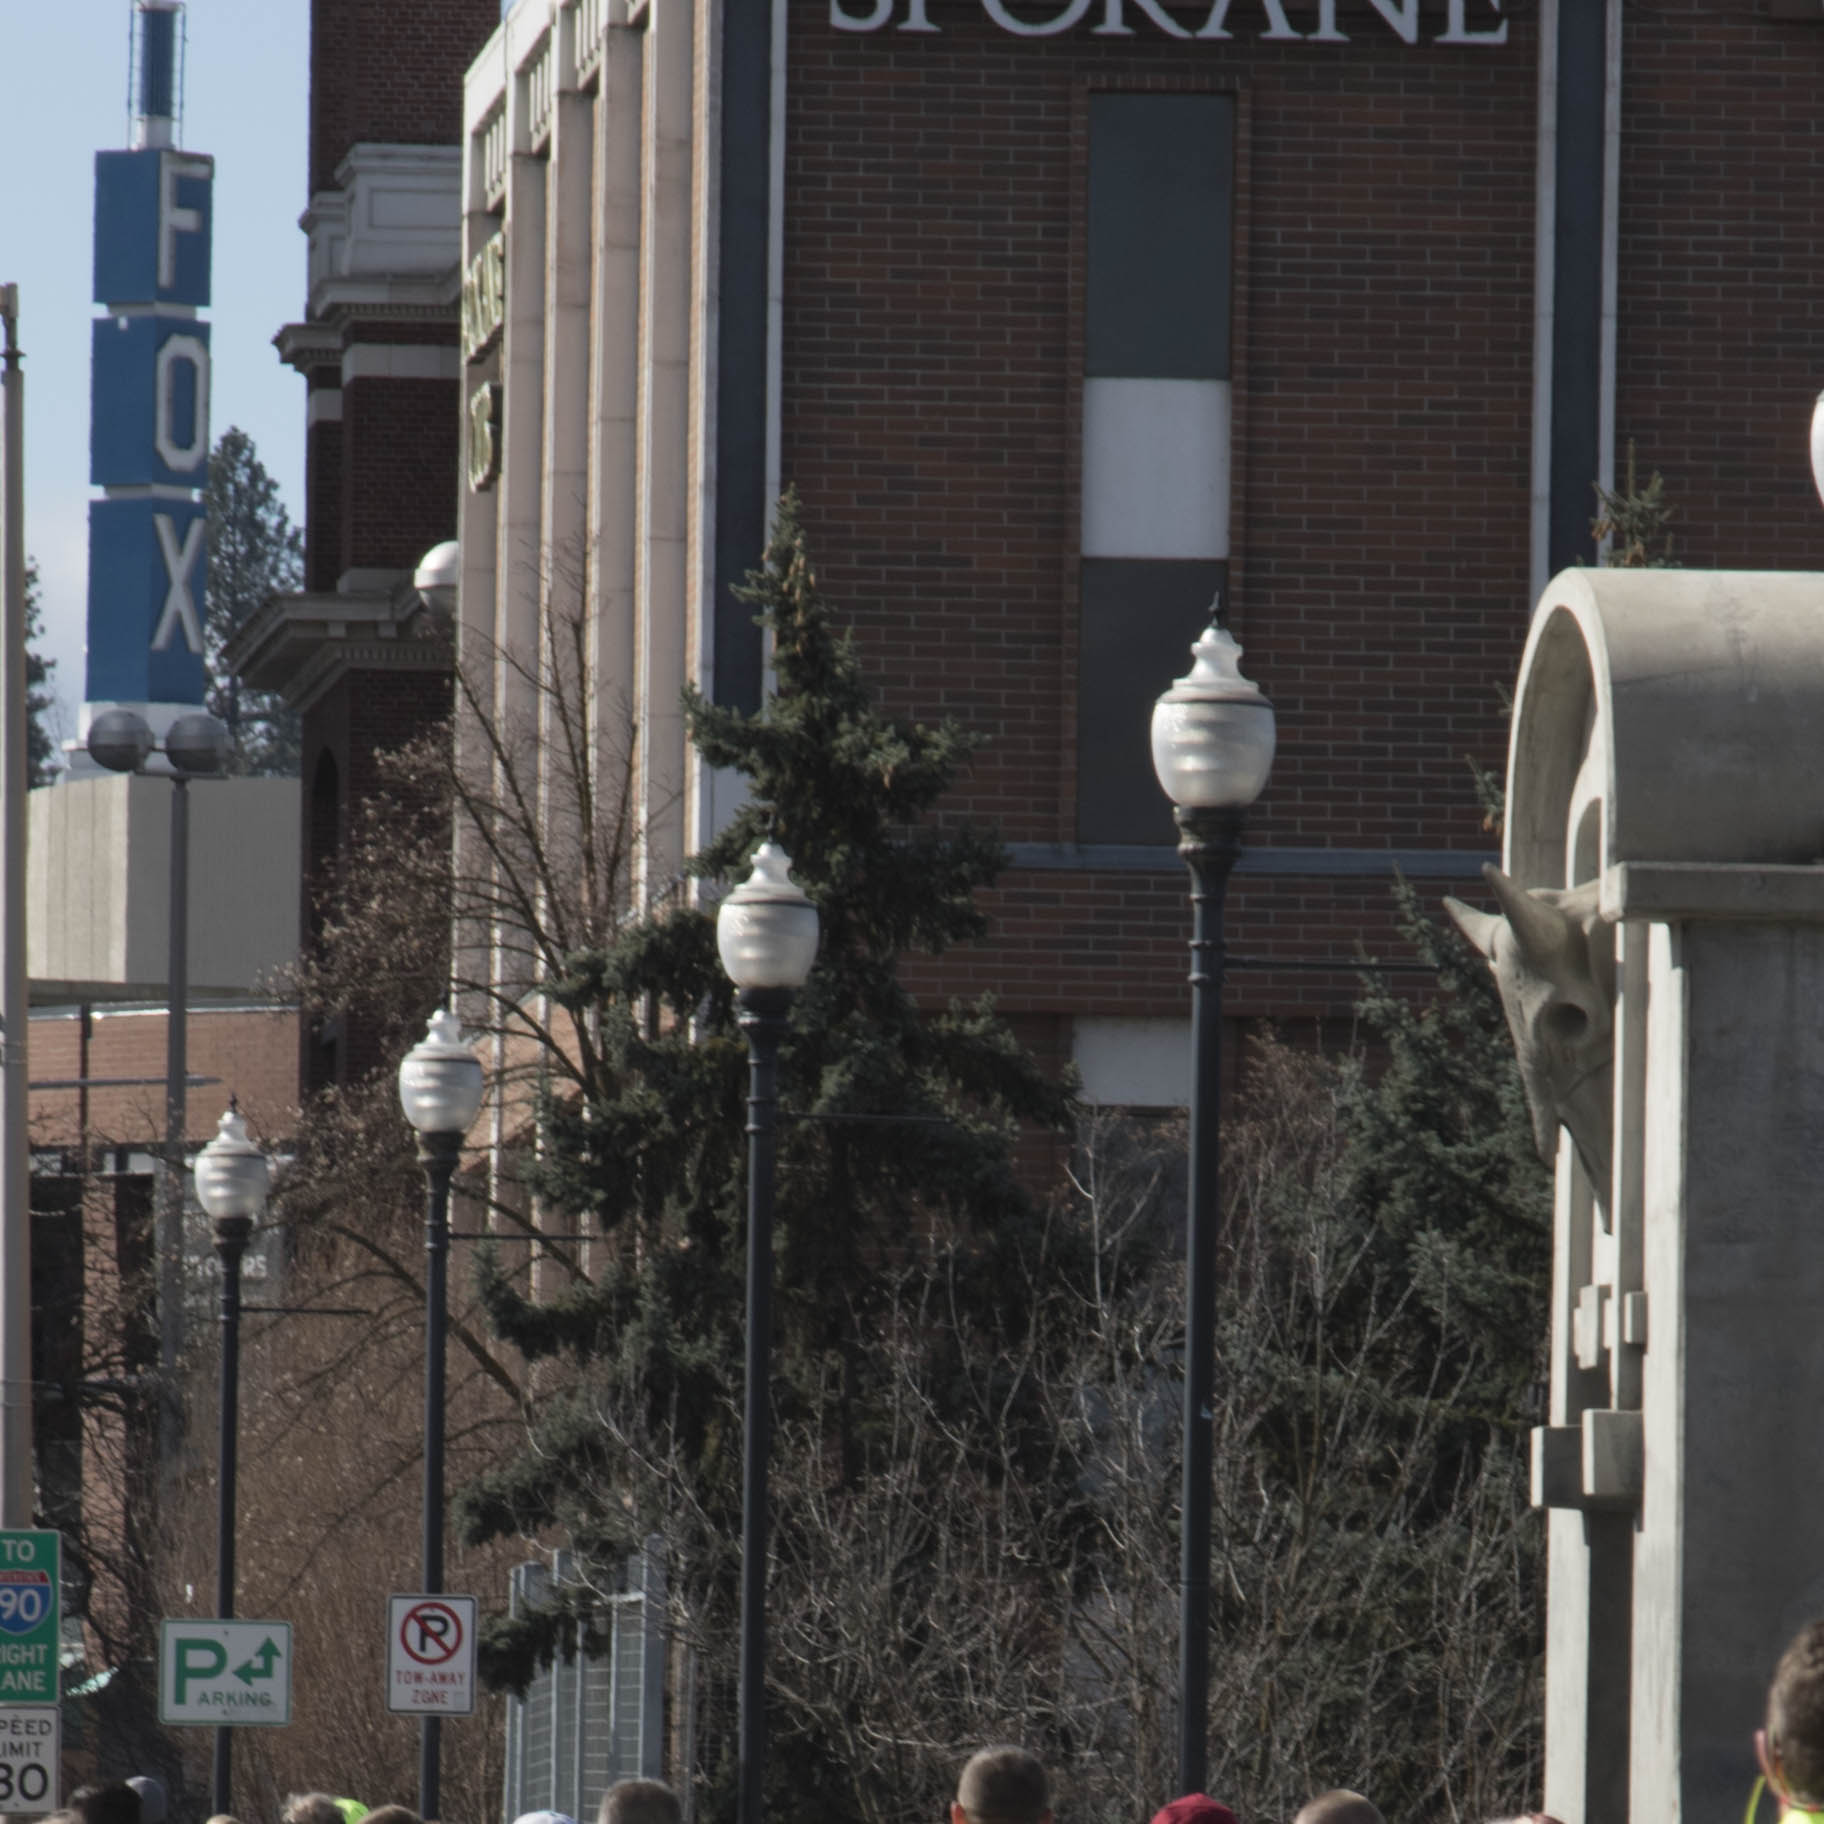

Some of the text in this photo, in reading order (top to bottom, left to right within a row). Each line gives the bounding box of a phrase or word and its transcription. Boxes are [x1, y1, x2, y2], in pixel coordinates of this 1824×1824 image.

[150, 151, 213, 653] FOX
[0, 1539, 36, 1562] TO
[395, 1669, 466, 1686] TOW-AWAY
[411, 1689, 449, 1705] ZONE
